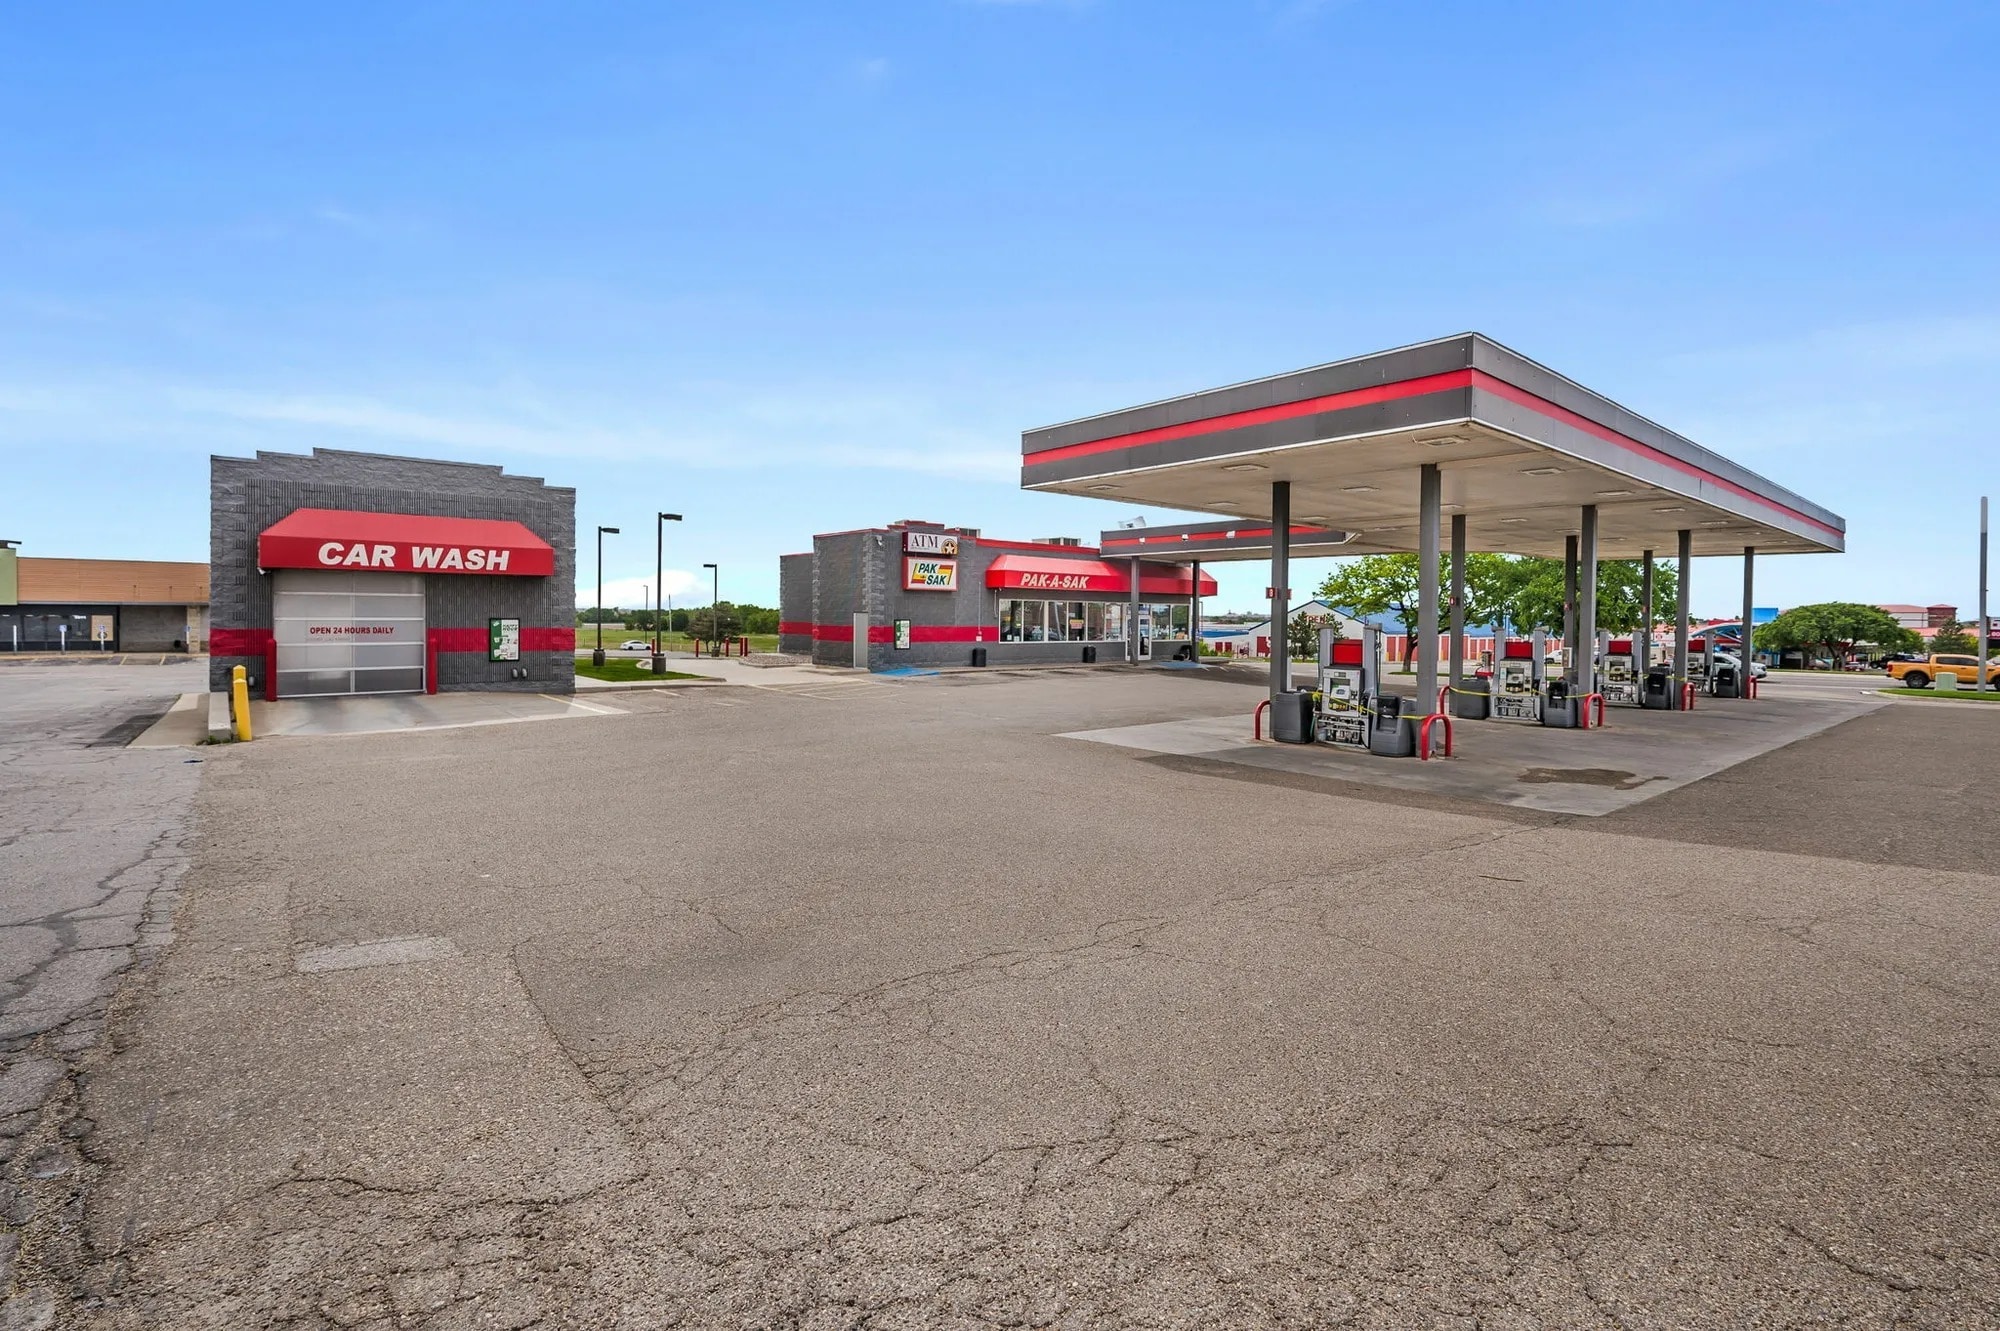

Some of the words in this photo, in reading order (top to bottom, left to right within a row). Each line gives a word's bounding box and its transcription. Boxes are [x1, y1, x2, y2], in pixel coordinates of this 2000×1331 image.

[911, 534, 939, 549] ATM
[318, 541, 397, 568] CAR
[411, 546, 510, 571] WASH
[918, 563, 938, 574] PAK
[926, 574, 947, 586] SAK
[1020, 572, 1090, 589] PAK-A-SAK
[310, 627, 332, 635] OPEN
[333, 627, 343, 635] 24
[344, 627, 371, 635] HOURS
